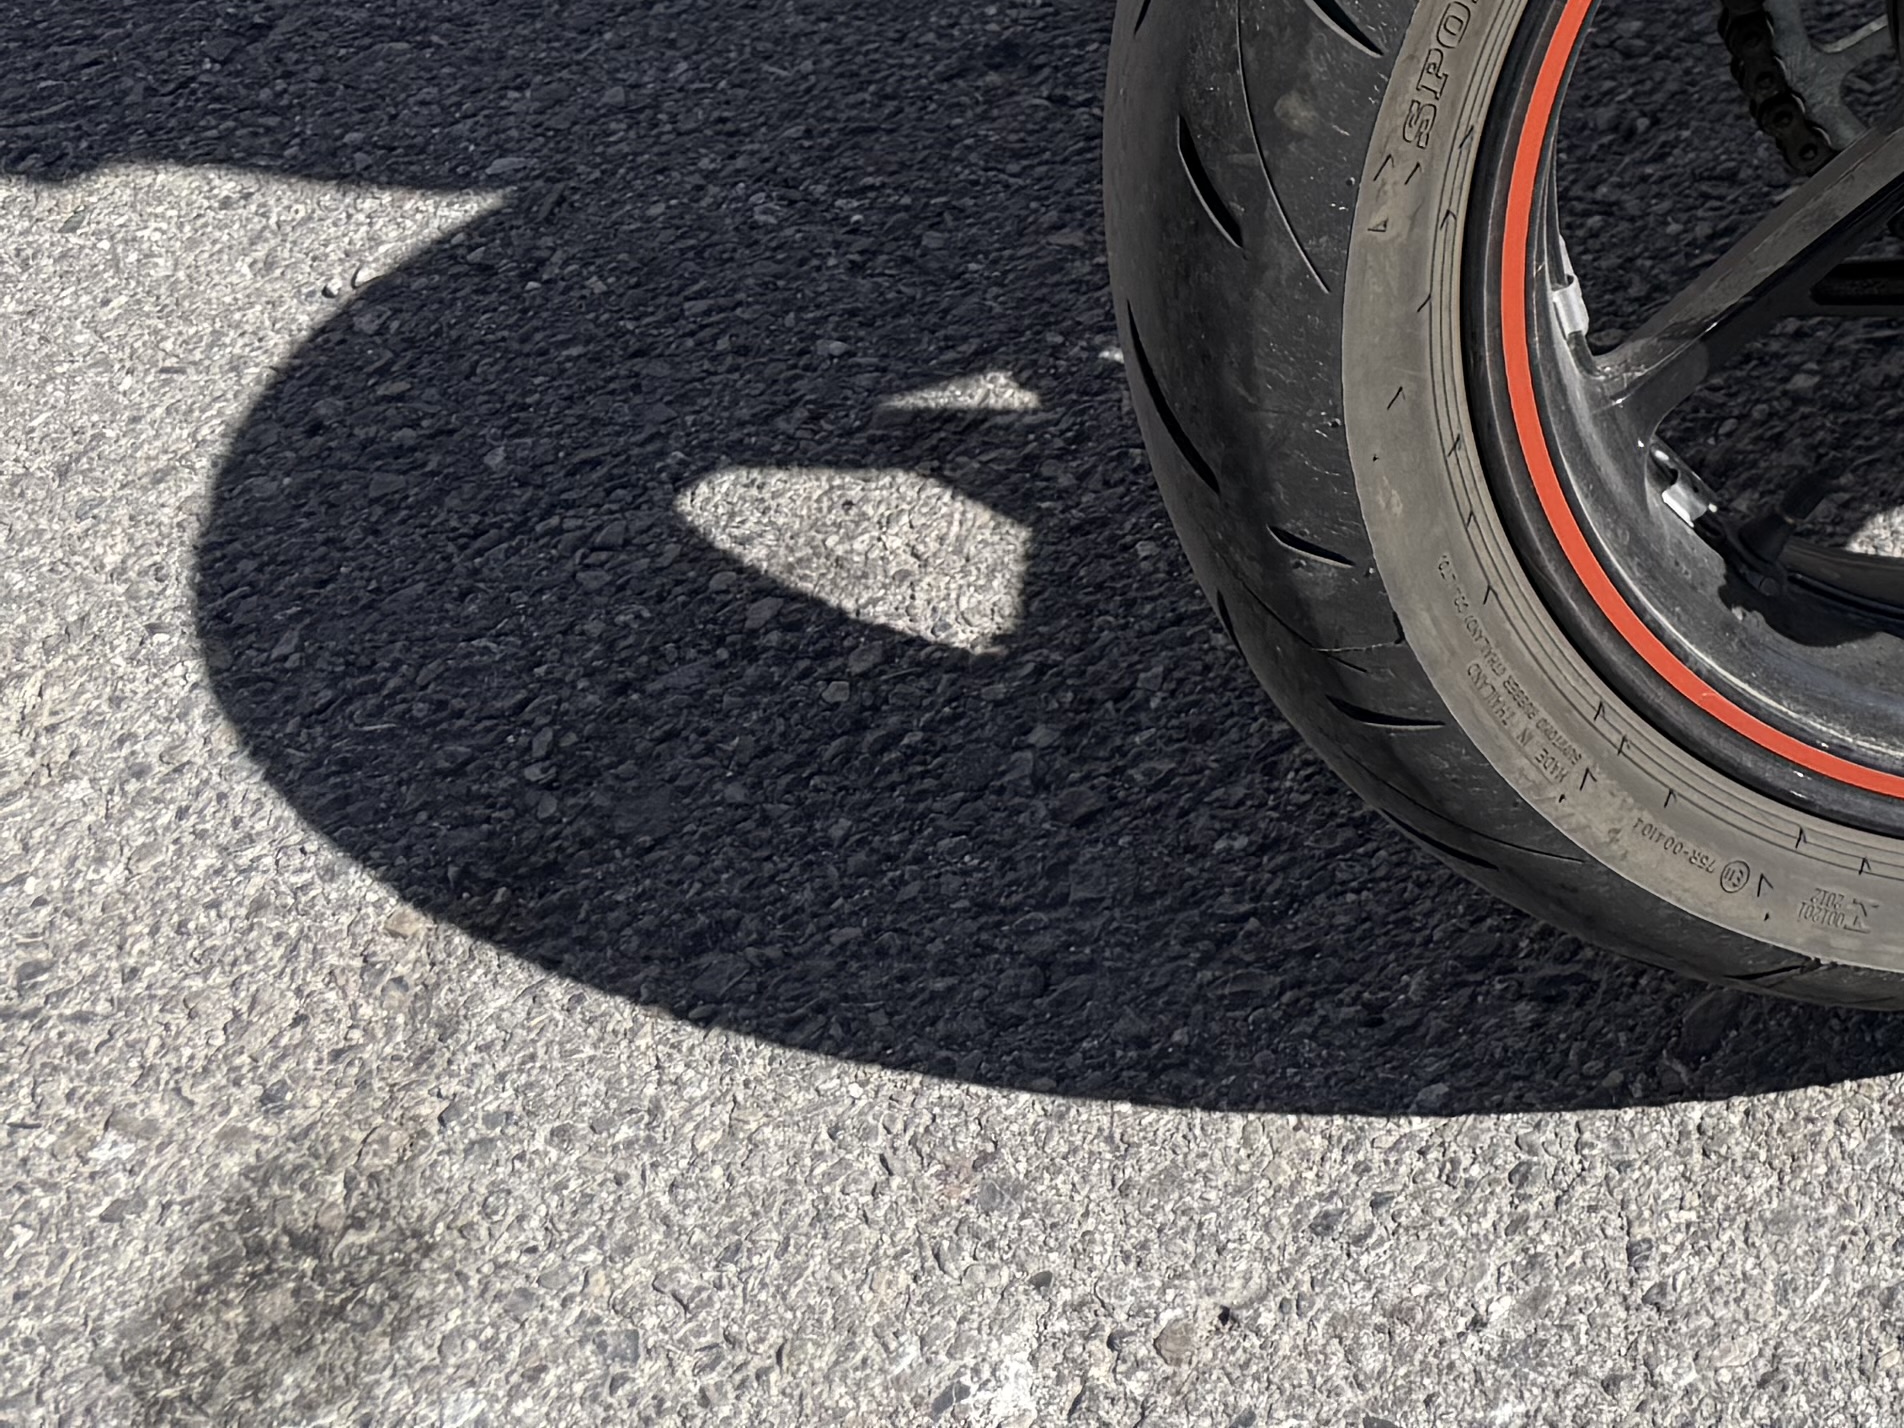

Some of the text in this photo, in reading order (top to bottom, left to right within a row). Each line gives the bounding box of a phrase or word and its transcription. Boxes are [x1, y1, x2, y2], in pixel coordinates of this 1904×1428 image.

[1466, 662, 1569, 784] MADE IN THAILAND
